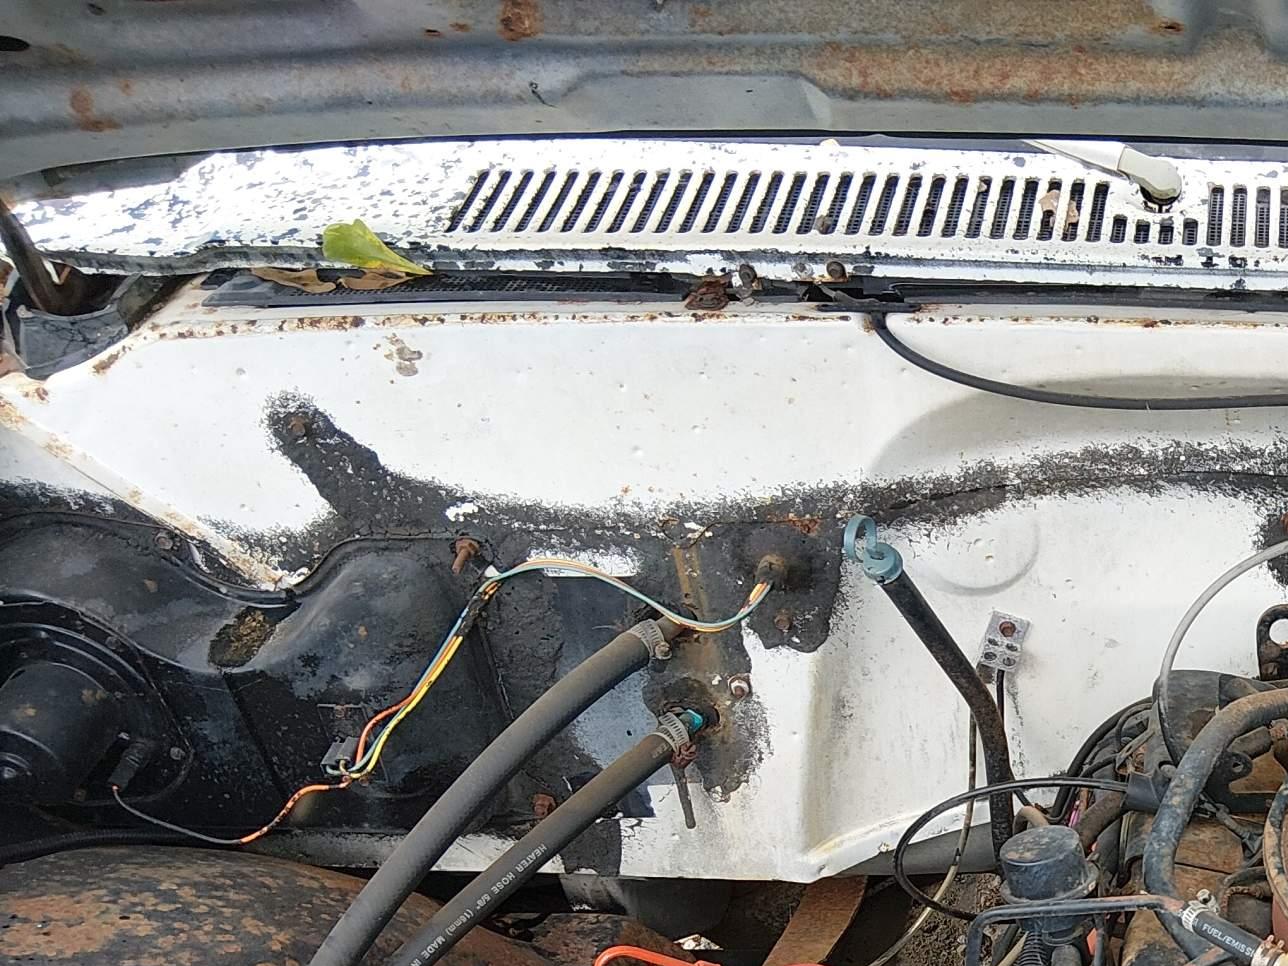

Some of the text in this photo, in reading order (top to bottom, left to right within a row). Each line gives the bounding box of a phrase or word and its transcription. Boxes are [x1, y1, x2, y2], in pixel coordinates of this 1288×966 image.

[515, 843, 548, 873] HEATER
[490, 871, 516, 894] HOSE
[445, 909, 475, 936] (16mm)
[421, 935, 446, 959] MADE
[1201, 923, 1255, 957] FUEL/EMISSI
